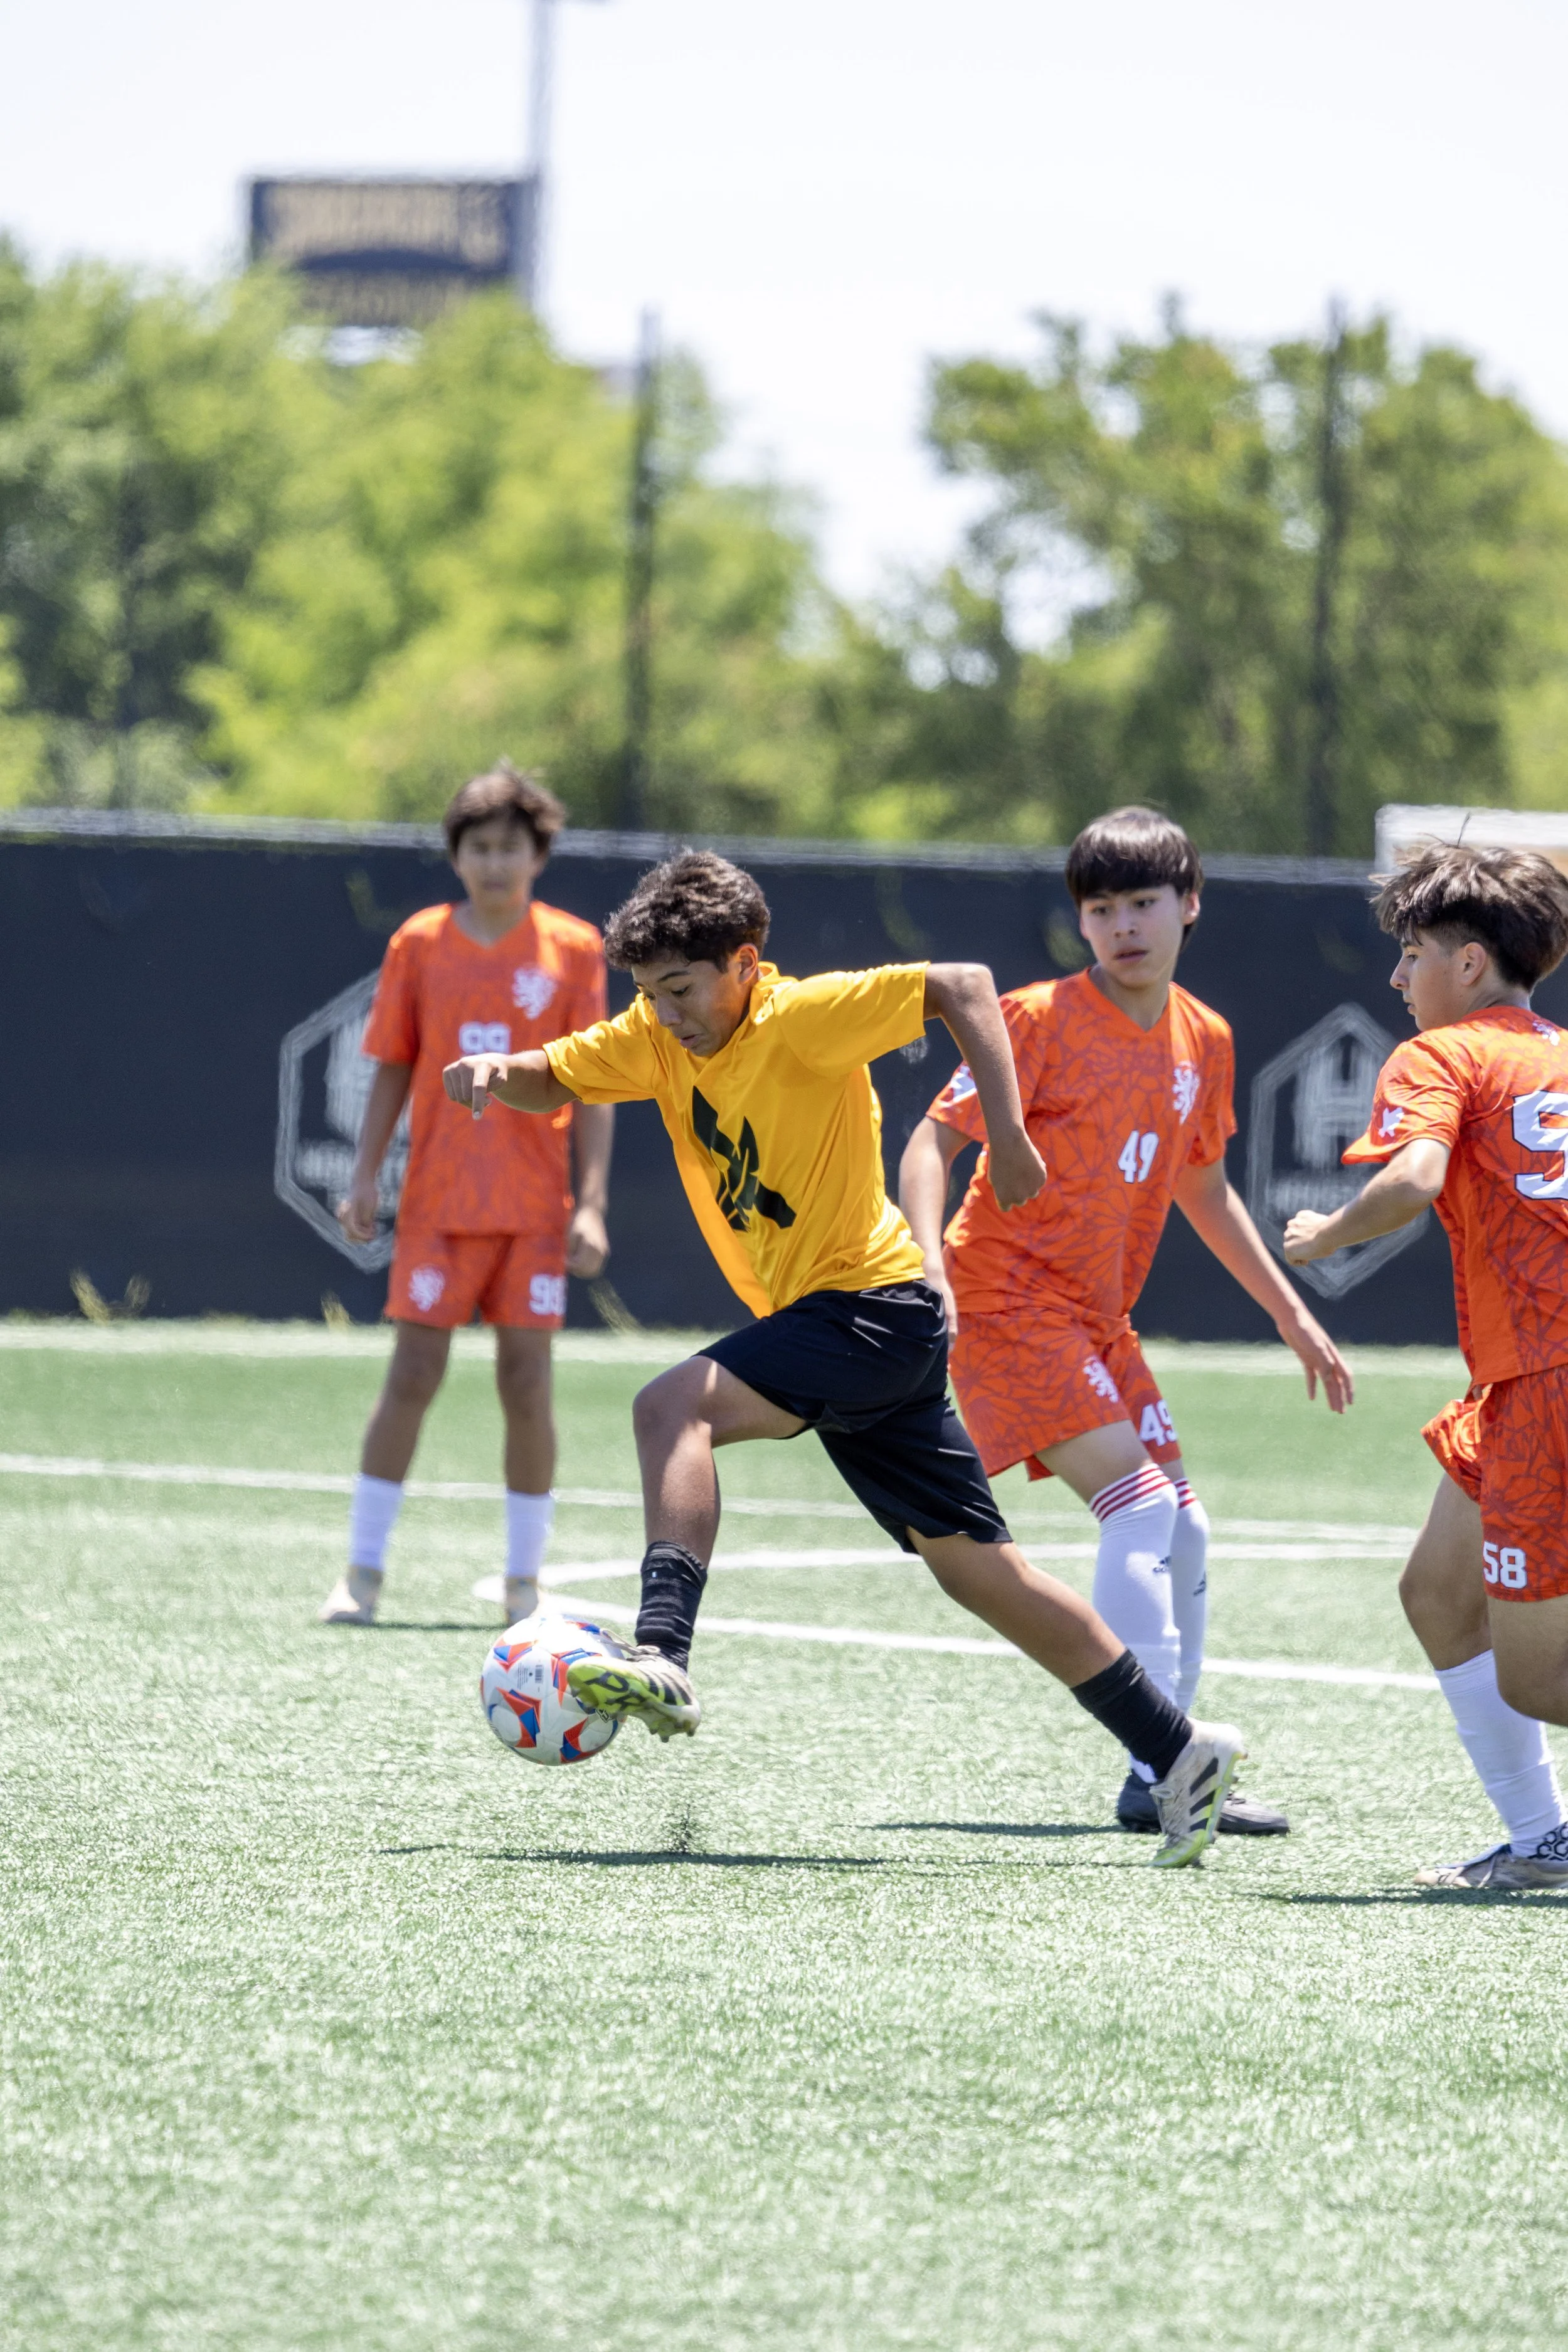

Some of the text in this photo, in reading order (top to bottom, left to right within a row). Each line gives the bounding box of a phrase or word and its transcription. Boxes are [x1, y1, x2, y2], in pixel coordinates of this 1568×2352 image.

[1118, 1129, 1159, 1184] 49
[1139, 1399, 1178, 1448] 49
[1483, 1540, 1527, 1589] 58
